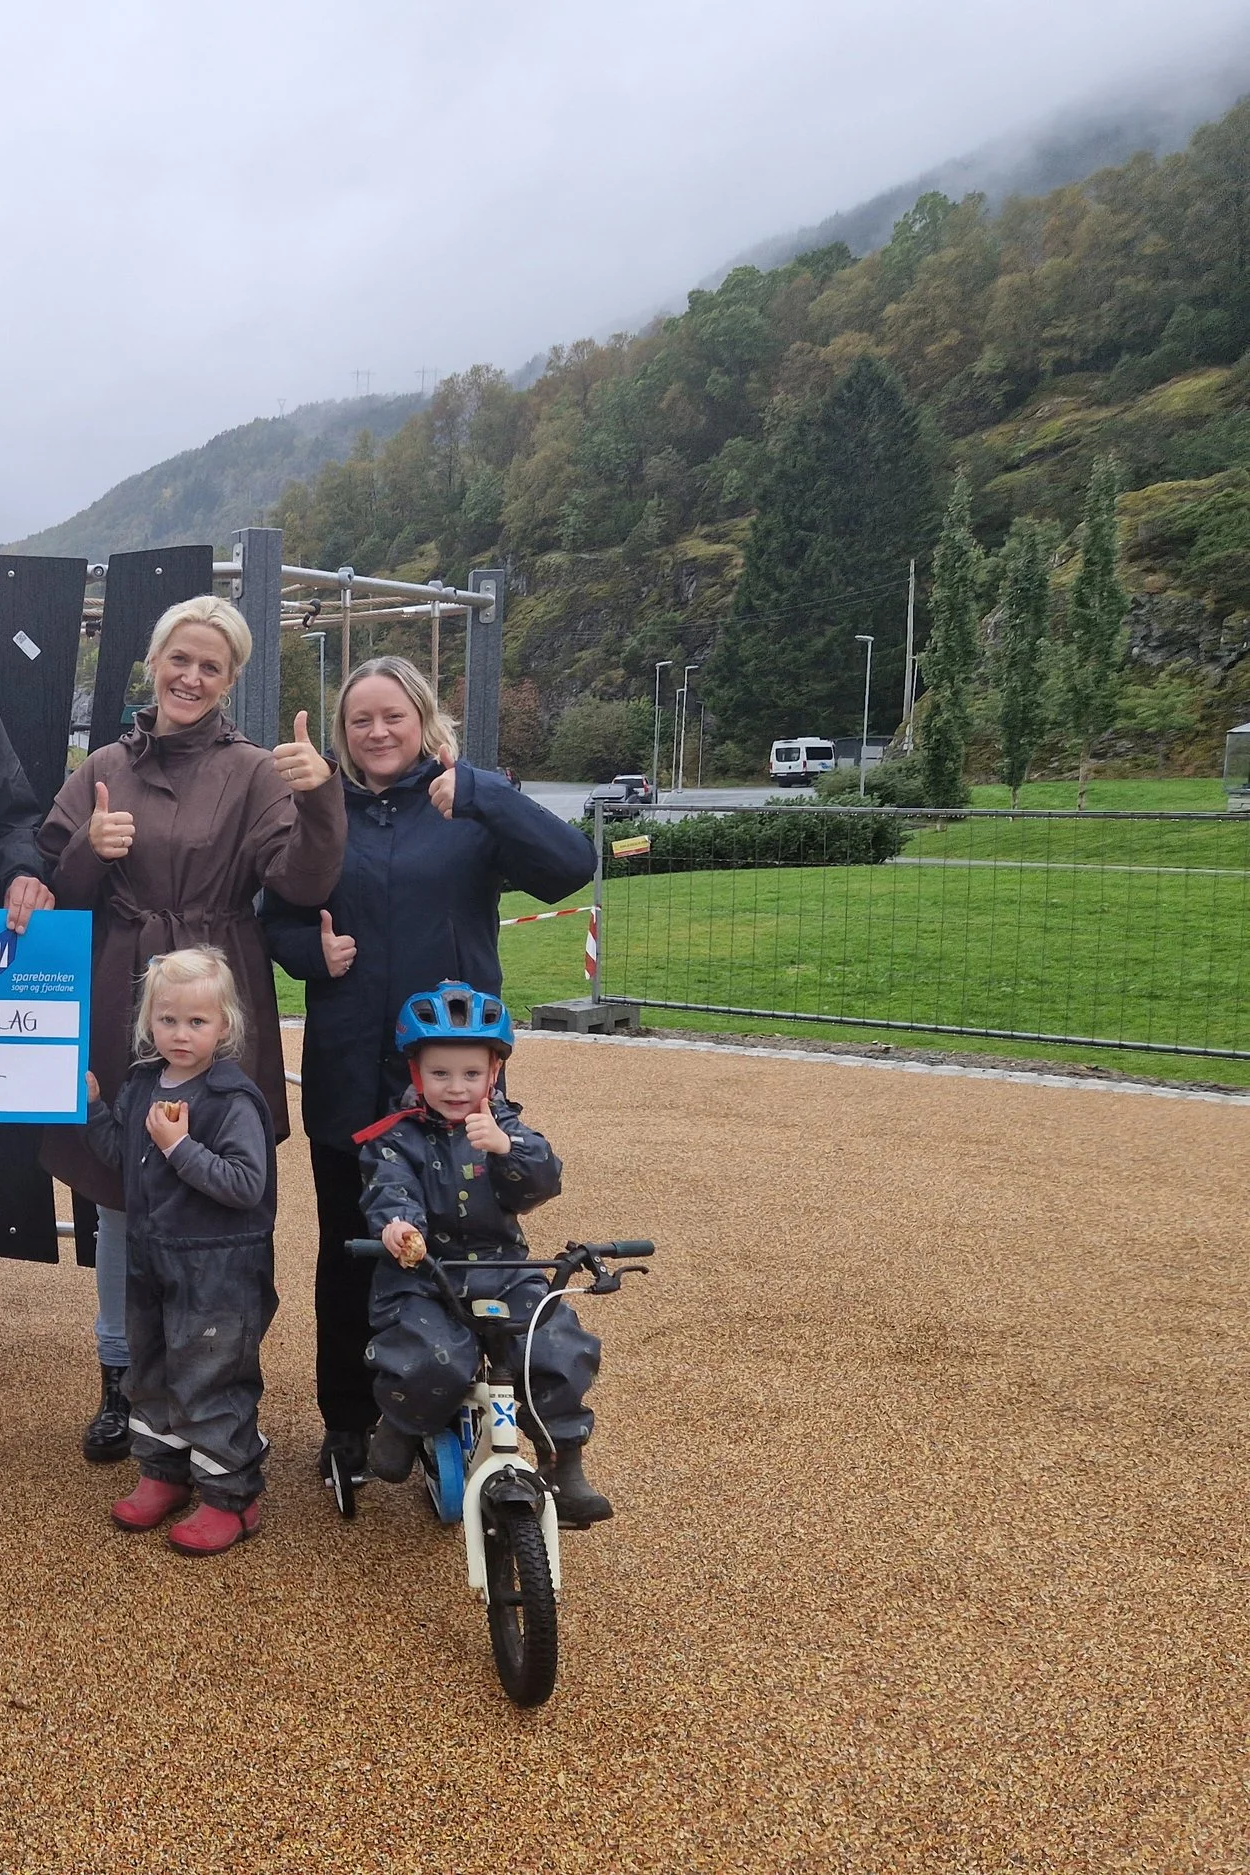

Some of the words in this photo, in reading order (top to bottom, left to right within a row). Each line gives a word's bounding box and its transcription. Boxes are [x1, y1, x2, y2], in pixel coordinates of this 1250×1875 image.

[11, 971, 75, 984] sparebanken
[11, 984, 29, 993] sogn
[30, 985, 40, 994] og
[40, 983, 74, 994] fjordane
